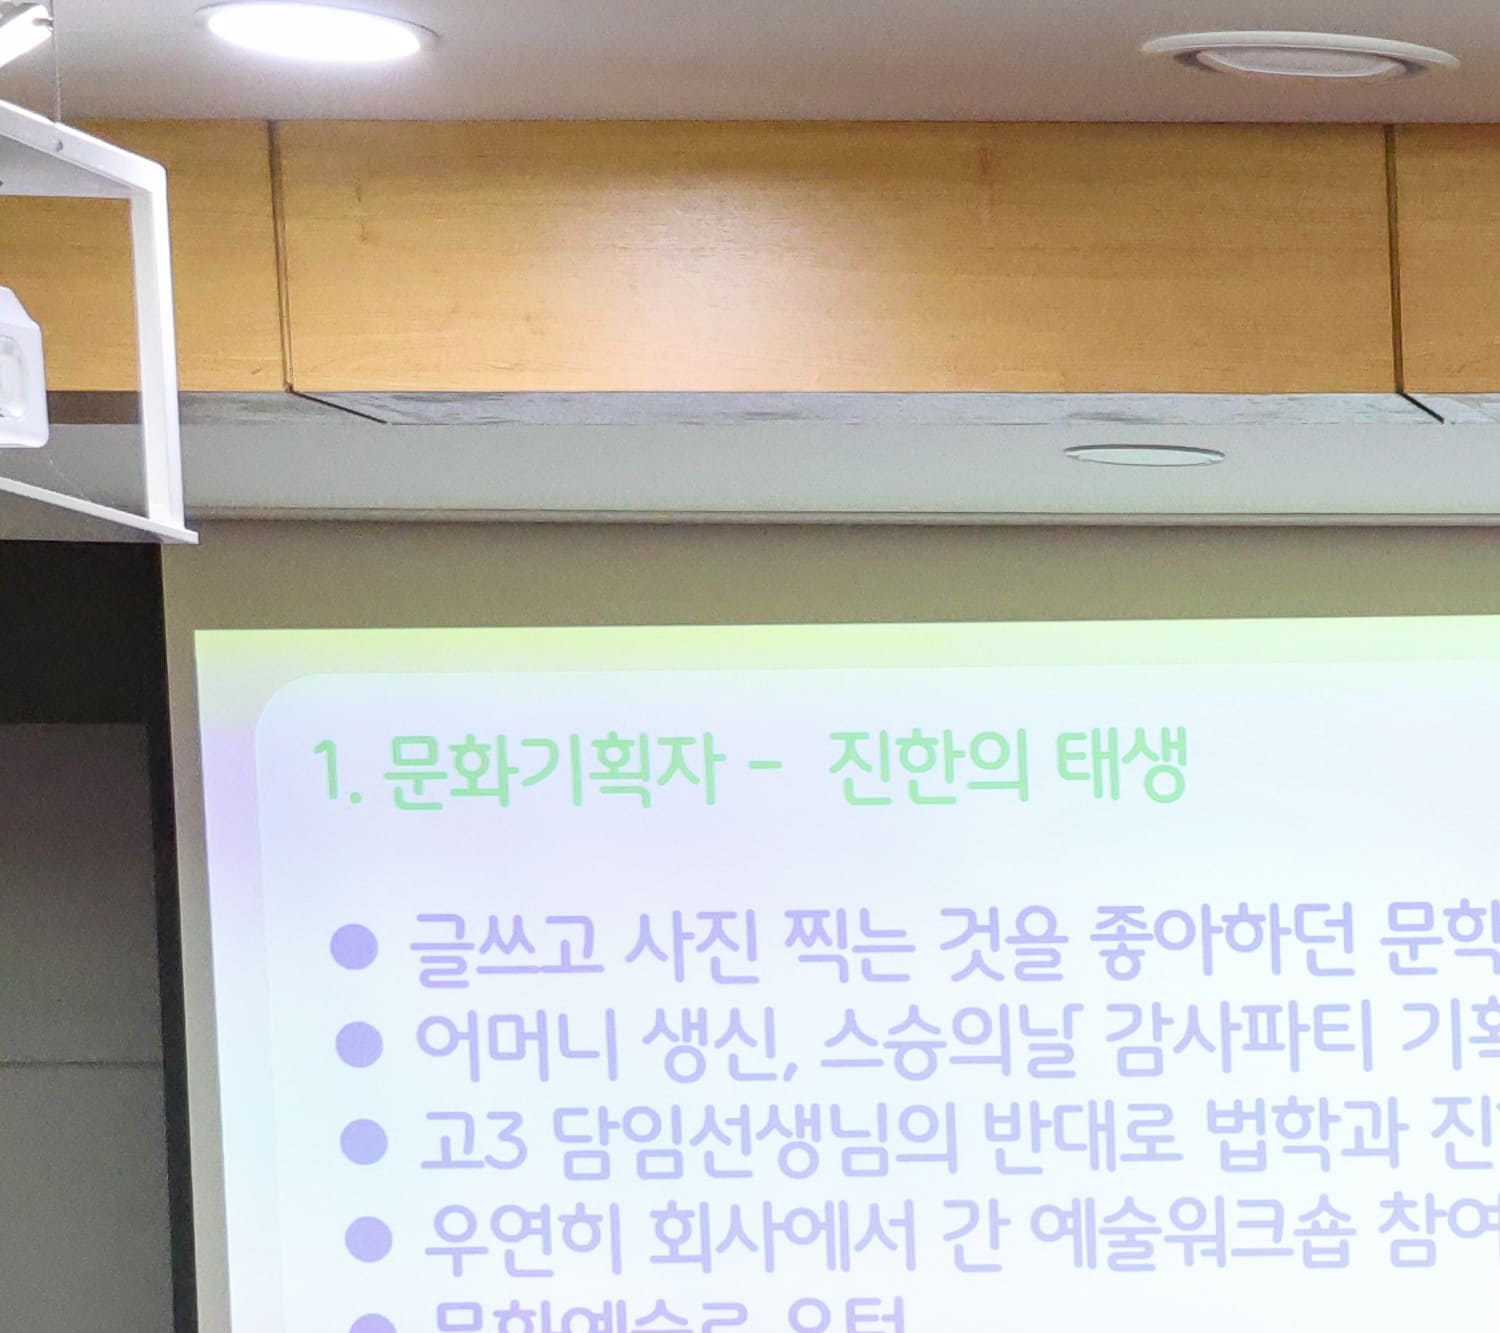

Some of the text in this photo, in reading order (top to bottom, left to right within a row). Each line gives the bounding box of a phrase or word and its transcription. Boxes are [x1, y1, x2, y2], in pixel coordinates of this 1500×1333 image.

[313, 739, 363, 804] 1.
[383, 731, 726, 811] 문화기획자
[829, 728, 1029, 806] 진한의
[1056, 726, 1187, 804] 태생
[410, 913, 605, 989] 글쓰고
[625, 909, 759, 984] 사진
[784, 908, 916, 983] 찍는
[940, 905, 1069, 982] 것을
[1090, 901, 1355, 981] 좋아하던
[416, 1008, 618, 1083] 어머니
[642, 1007, 798, 1084] 생신,
[820, 1003, 1084, 1081] 스승의날
[1106, 998, 1373, 1077] 감사파티
[420, 1111, 527, 1170] 고3
[553, 1102, 957, 1181] 담임선생님의
[984, 1100, 1183, 1175] 반대로
[1206, 1095, 1409, 1173] 법학과
[424, 1202, 621, 1277] 우연히
[649, 1199, 916, 1274] 회사에서
[943, 1198, 1011, 1273] 간
[1030, 1194, 1357, 1272] 예술워크숍
